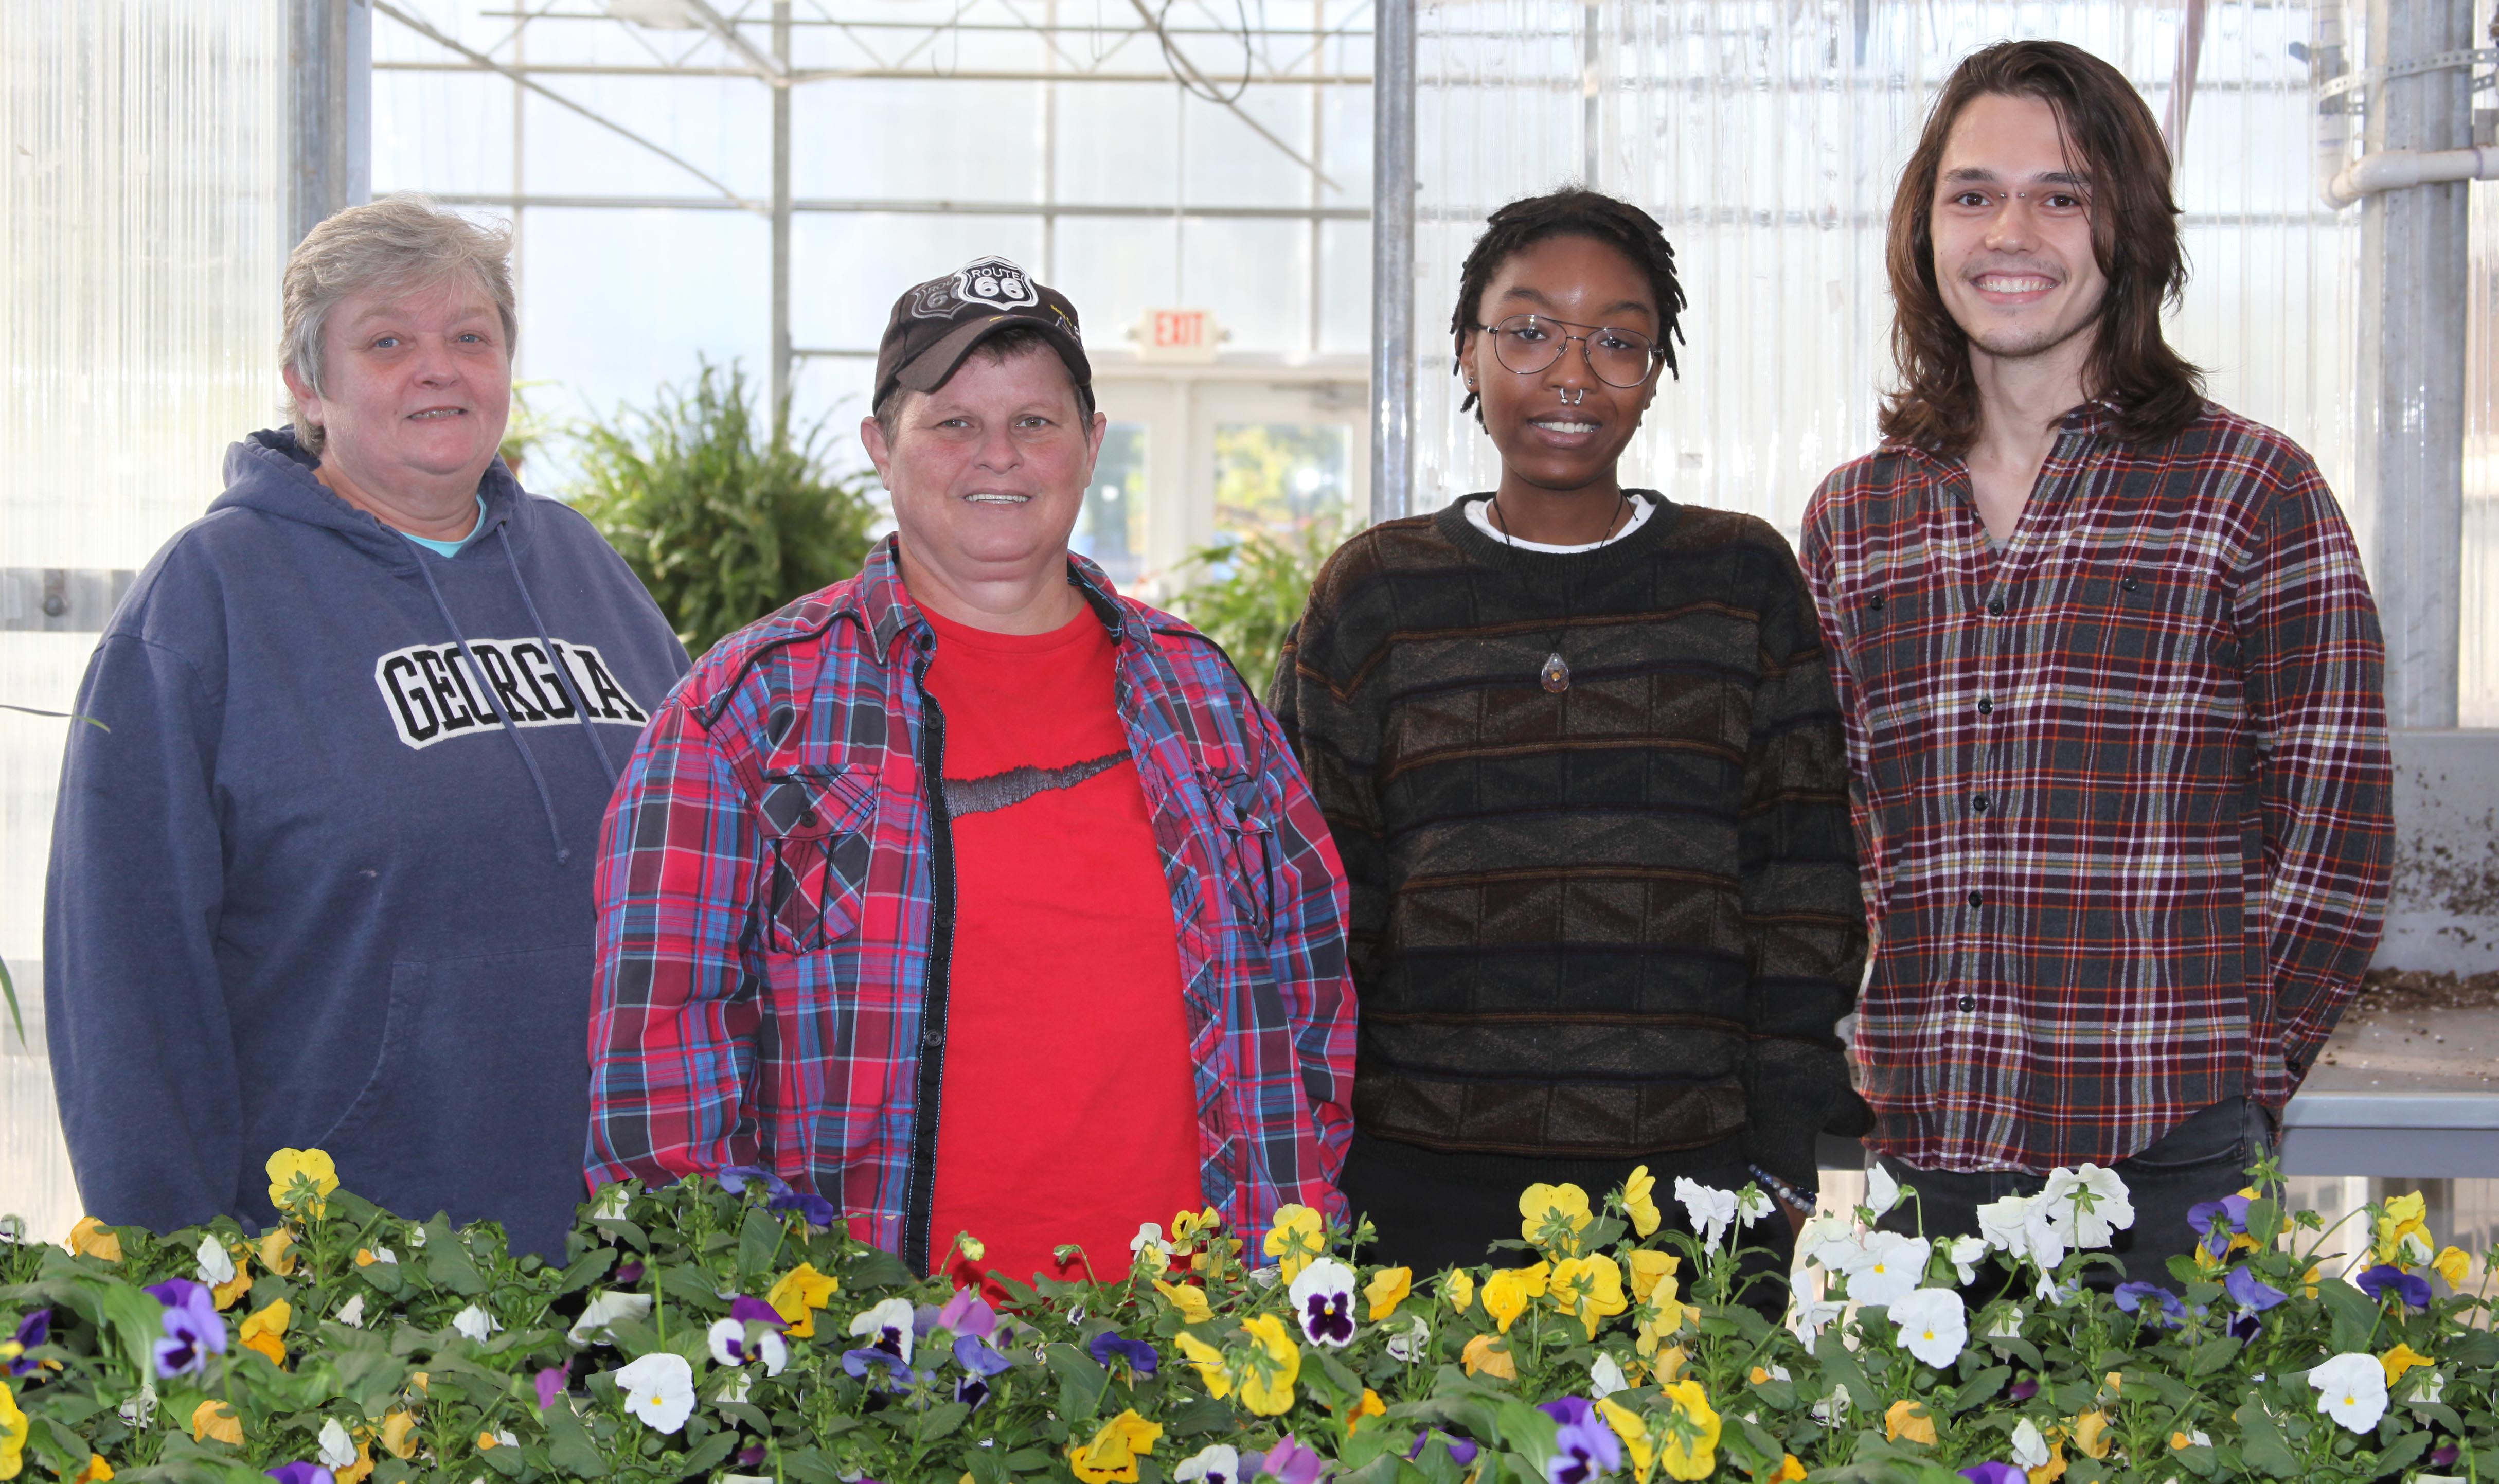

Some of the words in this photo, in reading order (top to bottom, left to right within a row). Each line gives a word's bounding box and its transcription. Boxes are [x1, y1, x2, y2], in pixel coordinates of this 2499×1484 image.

[927, 276, 956, 294] ROU
[971, 267, 1021, 281] ROUTE
[974, 276, 1025, 299] 66
[1155, 312, 1203, 347] EXIT
[383, 643, 647, 741] GEORGIA
